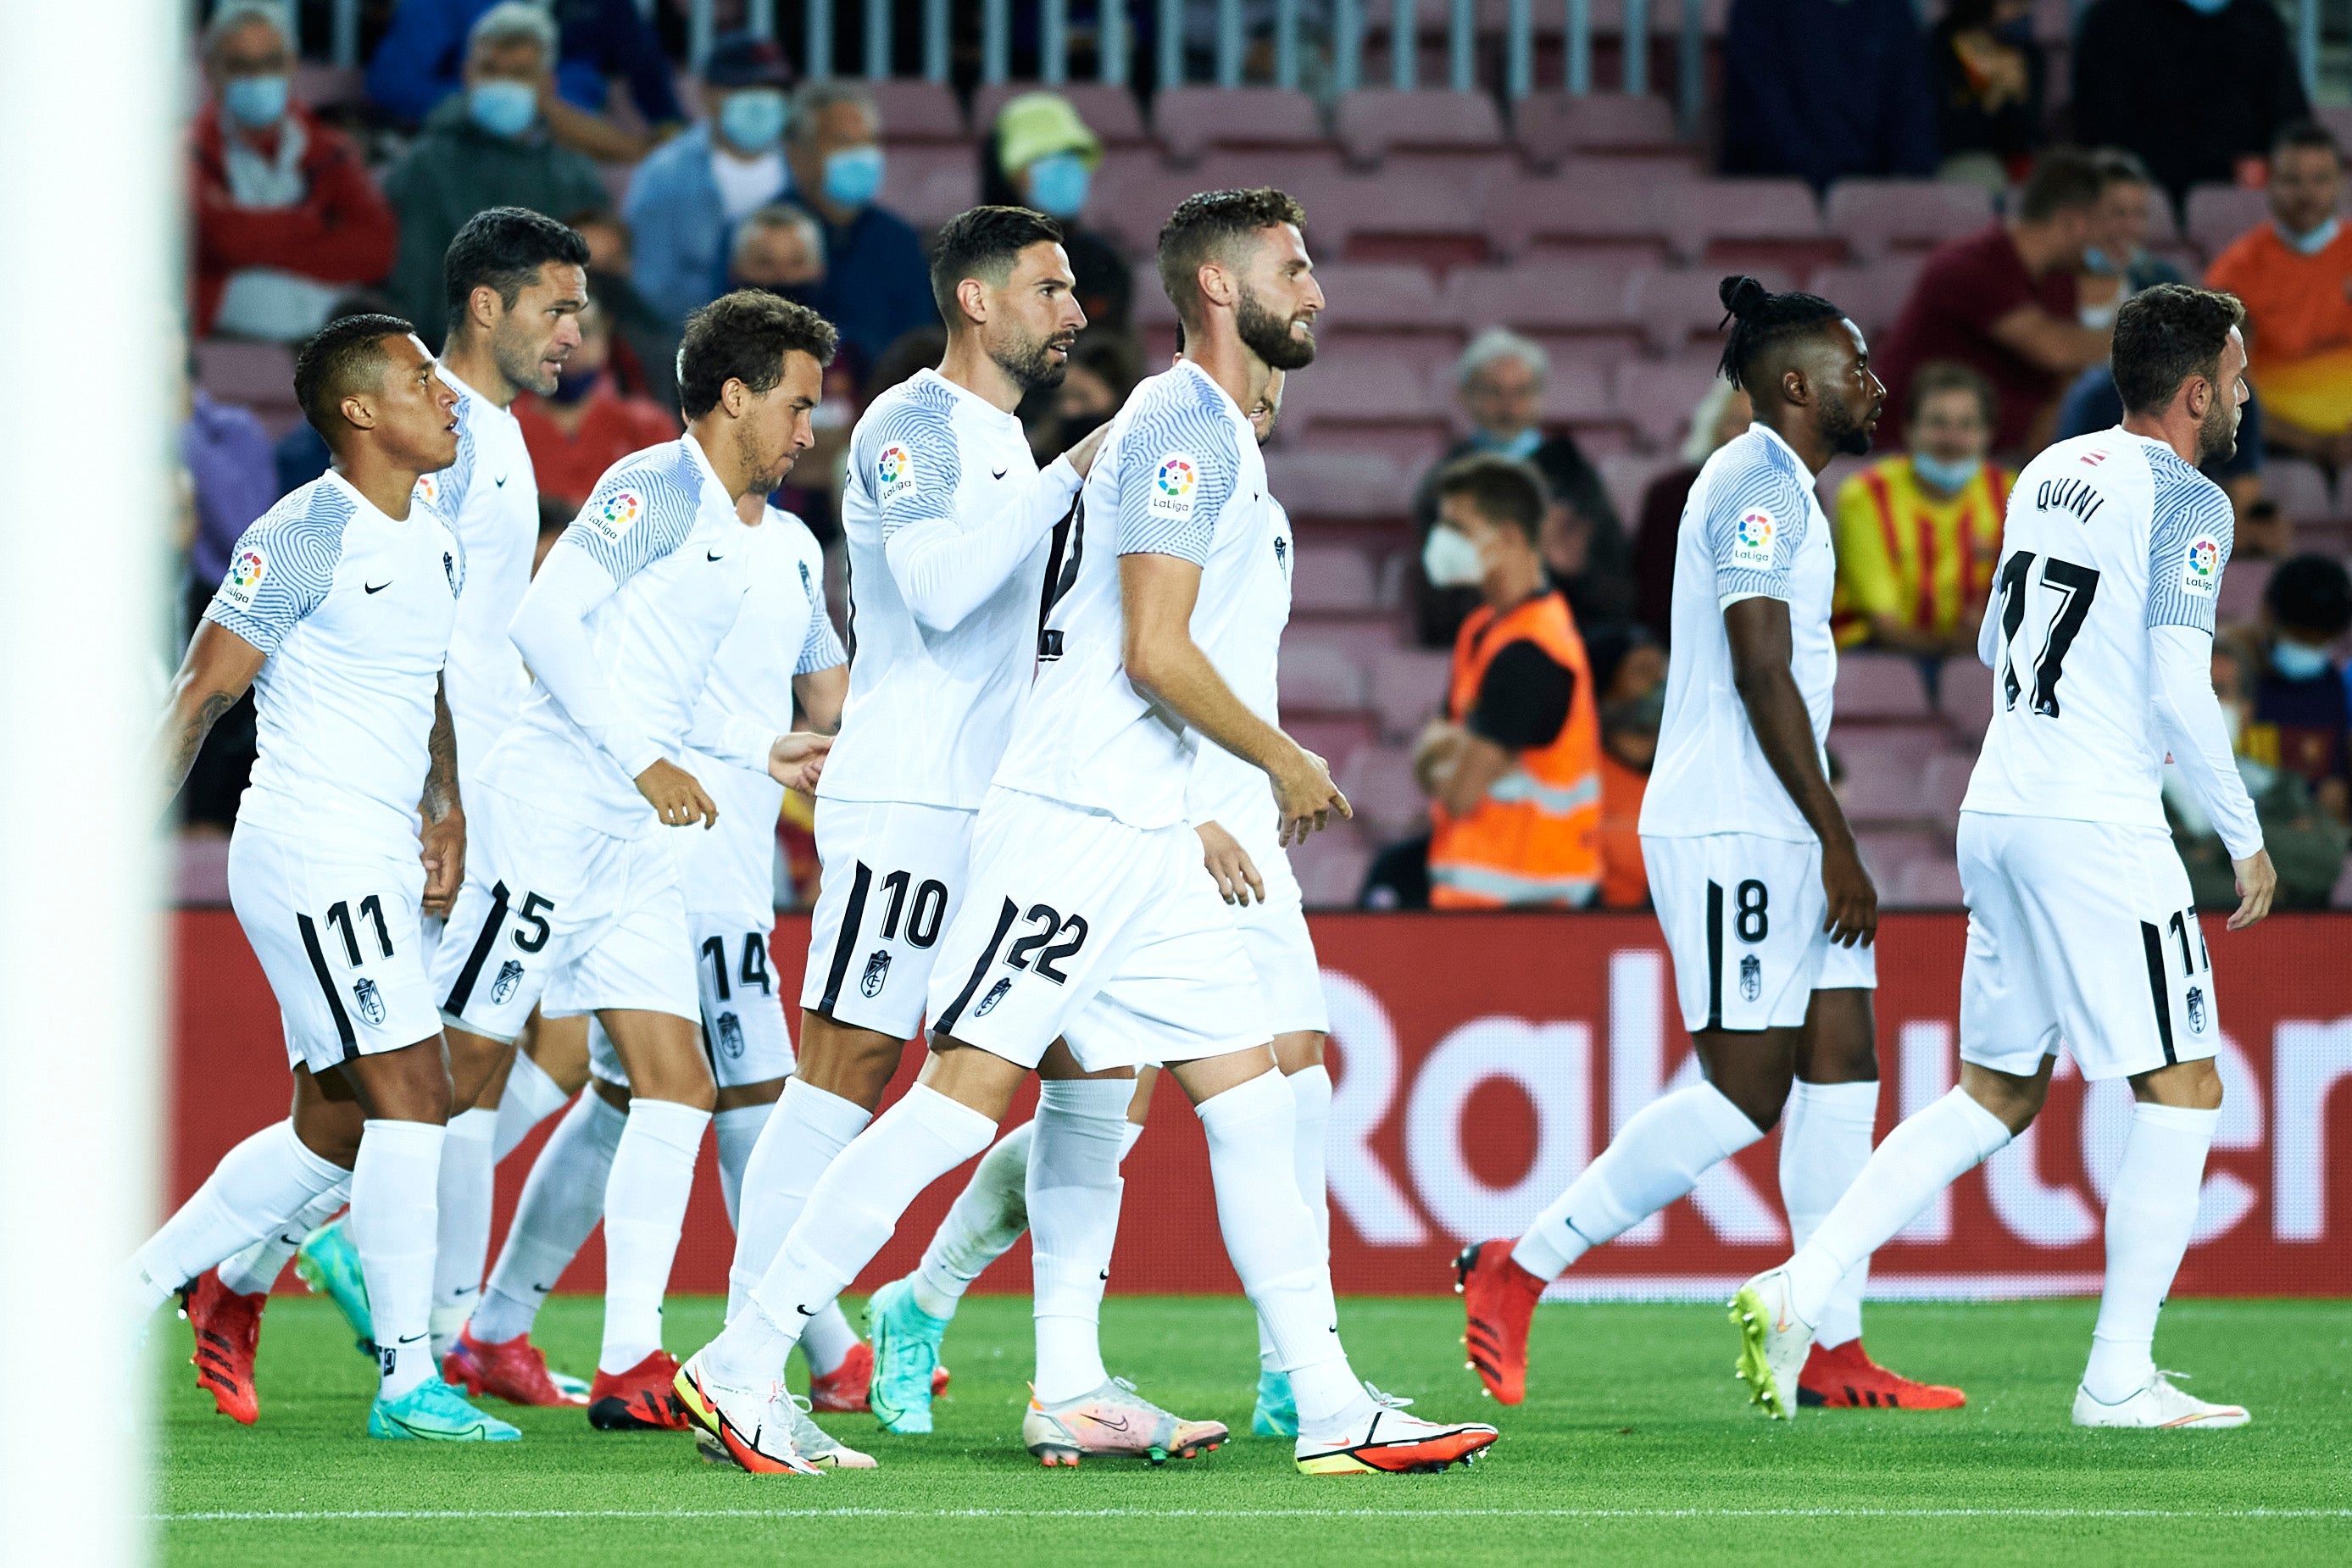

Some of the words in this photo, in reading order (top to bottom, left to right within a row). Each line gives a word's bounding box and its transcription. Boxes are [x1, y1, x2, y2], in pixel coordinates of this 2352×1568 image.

[1154, 498, 1189, 512] LaLiga
[2037, 478, 2105, 525] QUINI
[1735, 550, 1769, 563] LaLiga
[2000, 550, 2100, 719] 17
[324, 894, 395, 970] 11
[511, 890, 556, 954] 5
[879, 870, 948, 949] 10
[1733, 878, 1769, 945] 8
[699, 932, 770, 1003] 14
[1003, 904, 1089, 987] 22
[1317, 945, 2352, 1248] Rakten
